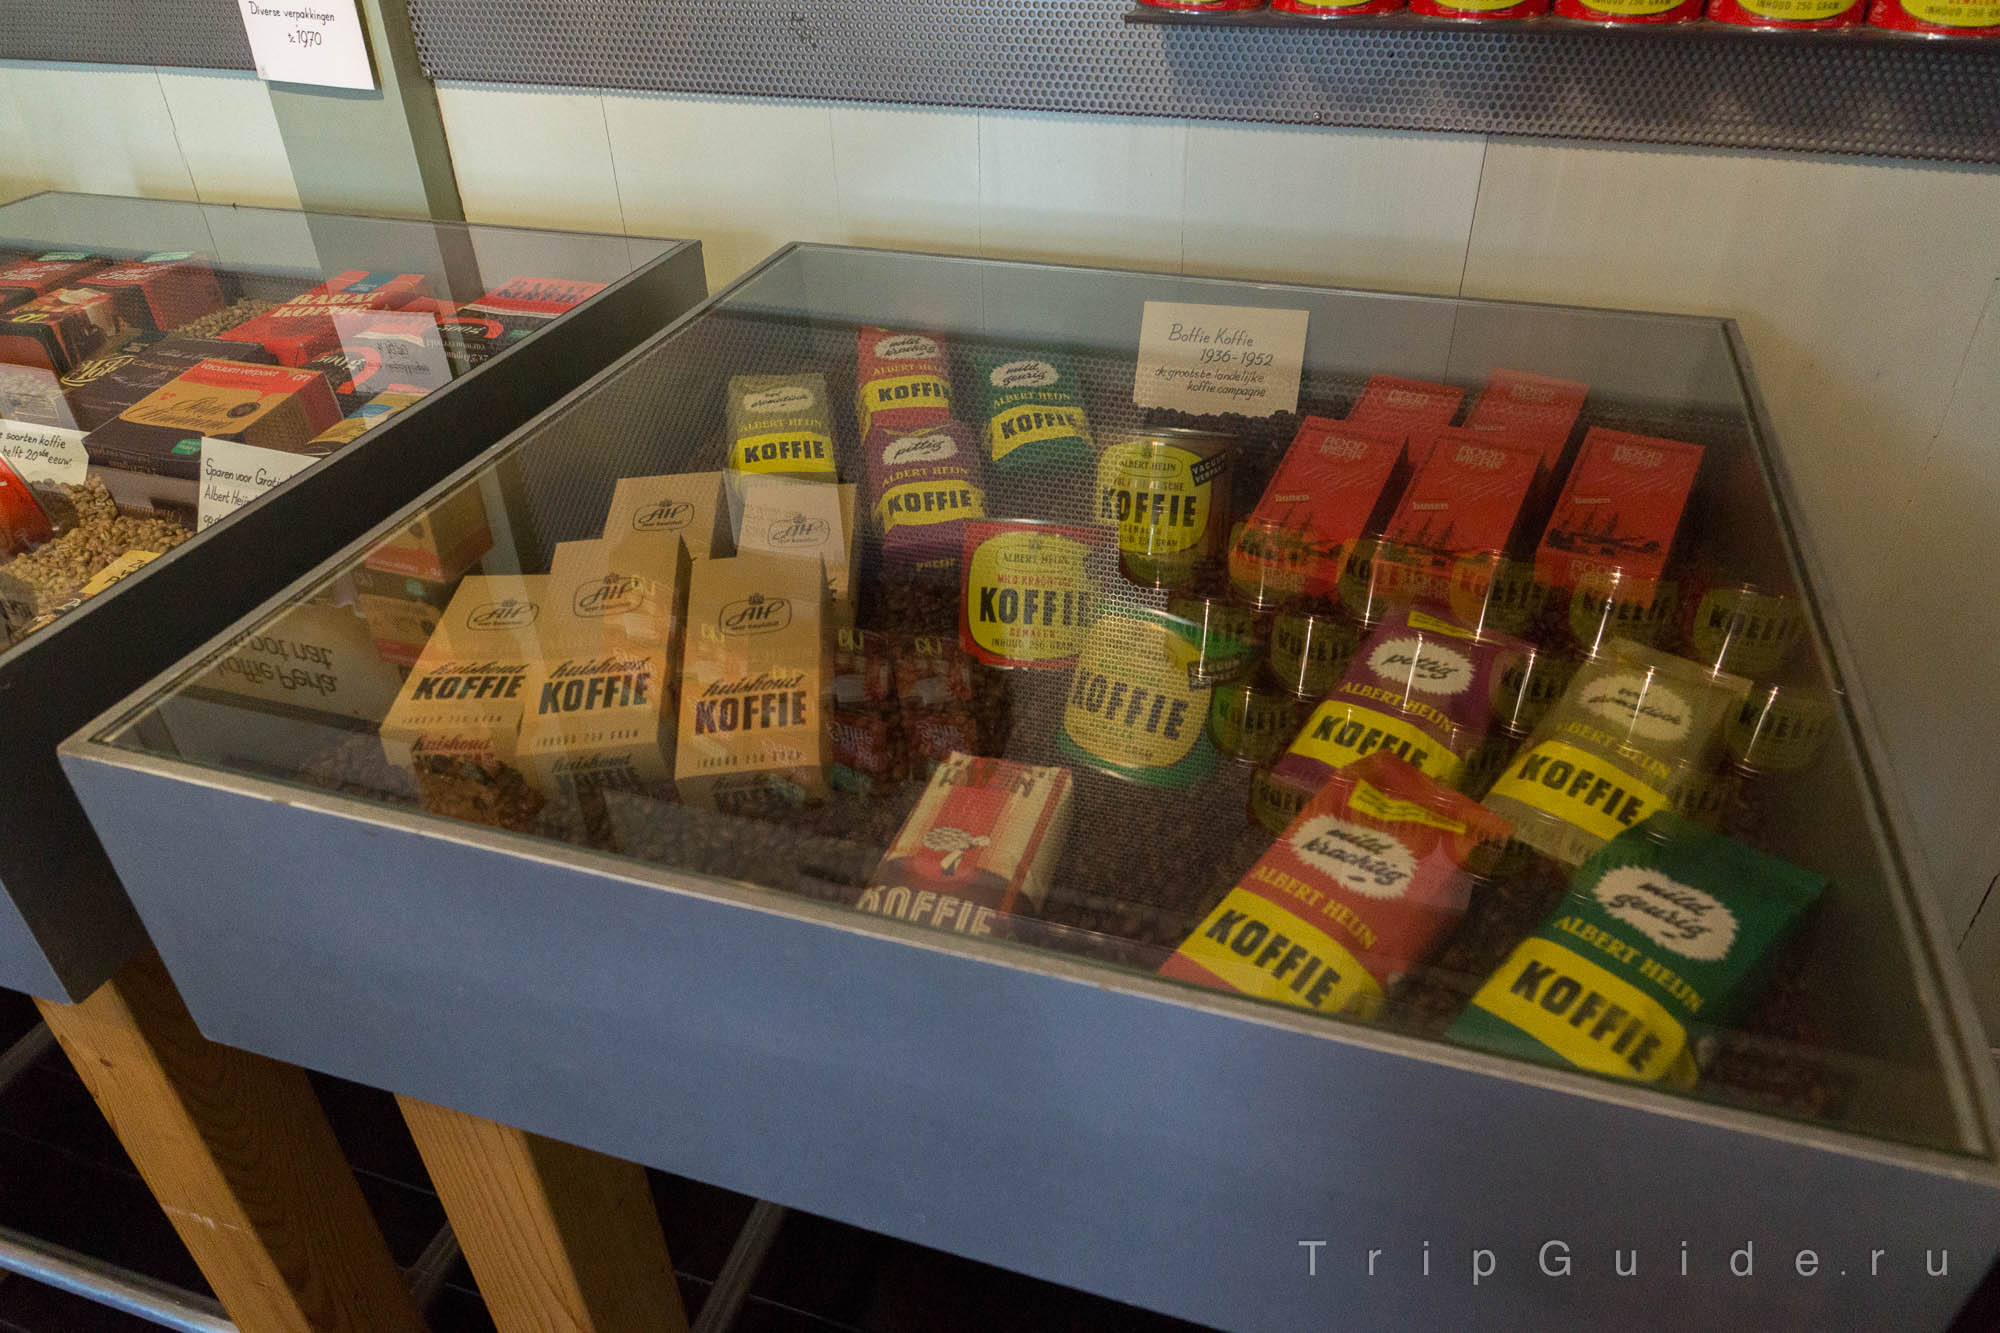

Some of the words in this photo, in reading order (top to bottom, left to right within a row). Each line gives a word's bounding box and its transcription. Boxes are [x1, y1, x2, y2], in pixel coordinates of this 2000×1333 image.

[248, 0, 281, 17] Diverse
[283, 7, 335, 26] verpakkingen
[296, 29, 322, 48] 1970
[1168, 323, 1210, 344] Boffie
[1213, 327, 1255, 348] Koffie
[1187, 380, 1216, 393] koffie
[1217, 385, 1267, 400] campagne
[1214, 369, 1265, 384] landelijke
[6, 431, 37, 445] soorten
[38, 433, 66, 449] koffie
[1000, 411, 1076, 440] KOFFIE
[3, 444, 24, 459] helft
[743, 439, 825, 464] KOFFIE
[205, 457, 233, 481] Sparen
[235, 472, 253, 484] voor
[255, 467, 282, 488] Grati
[204, 483, 231, 504] Albert
[231, 489, 250, 507] Heij
[887, 489, 972, 516] KOFFIE
[1101, 488, 1197, 528] KOFFIE
[979, 585, 1088, 627] KOFFIE
[410, 674, 527, 701] KOFFIE
[537, 671, 651, 715] KOFFIE
[1339, 680, 1403, 706] ALBERT
[694, 690, 808, 736] KOFFIE
[1071, 667, 1189, 741] KOFFIE
[1312, 714, 1428, 769] KOFFIE
[1516, 753, 1645, 826] KOFFIE
[1326, 828, 1395, 854] mild
[1250, 865, 1324, 907] ALBERT
[1637, 881, 1714, 916] mild
[855, 884, 997, 936] KOFFIE
[1553, 914, 1642, 966] ALBERT
[1204, 909, 1341, 1008] KOFFIE
[1509, 959, 1662, 1072] KOFFIE
